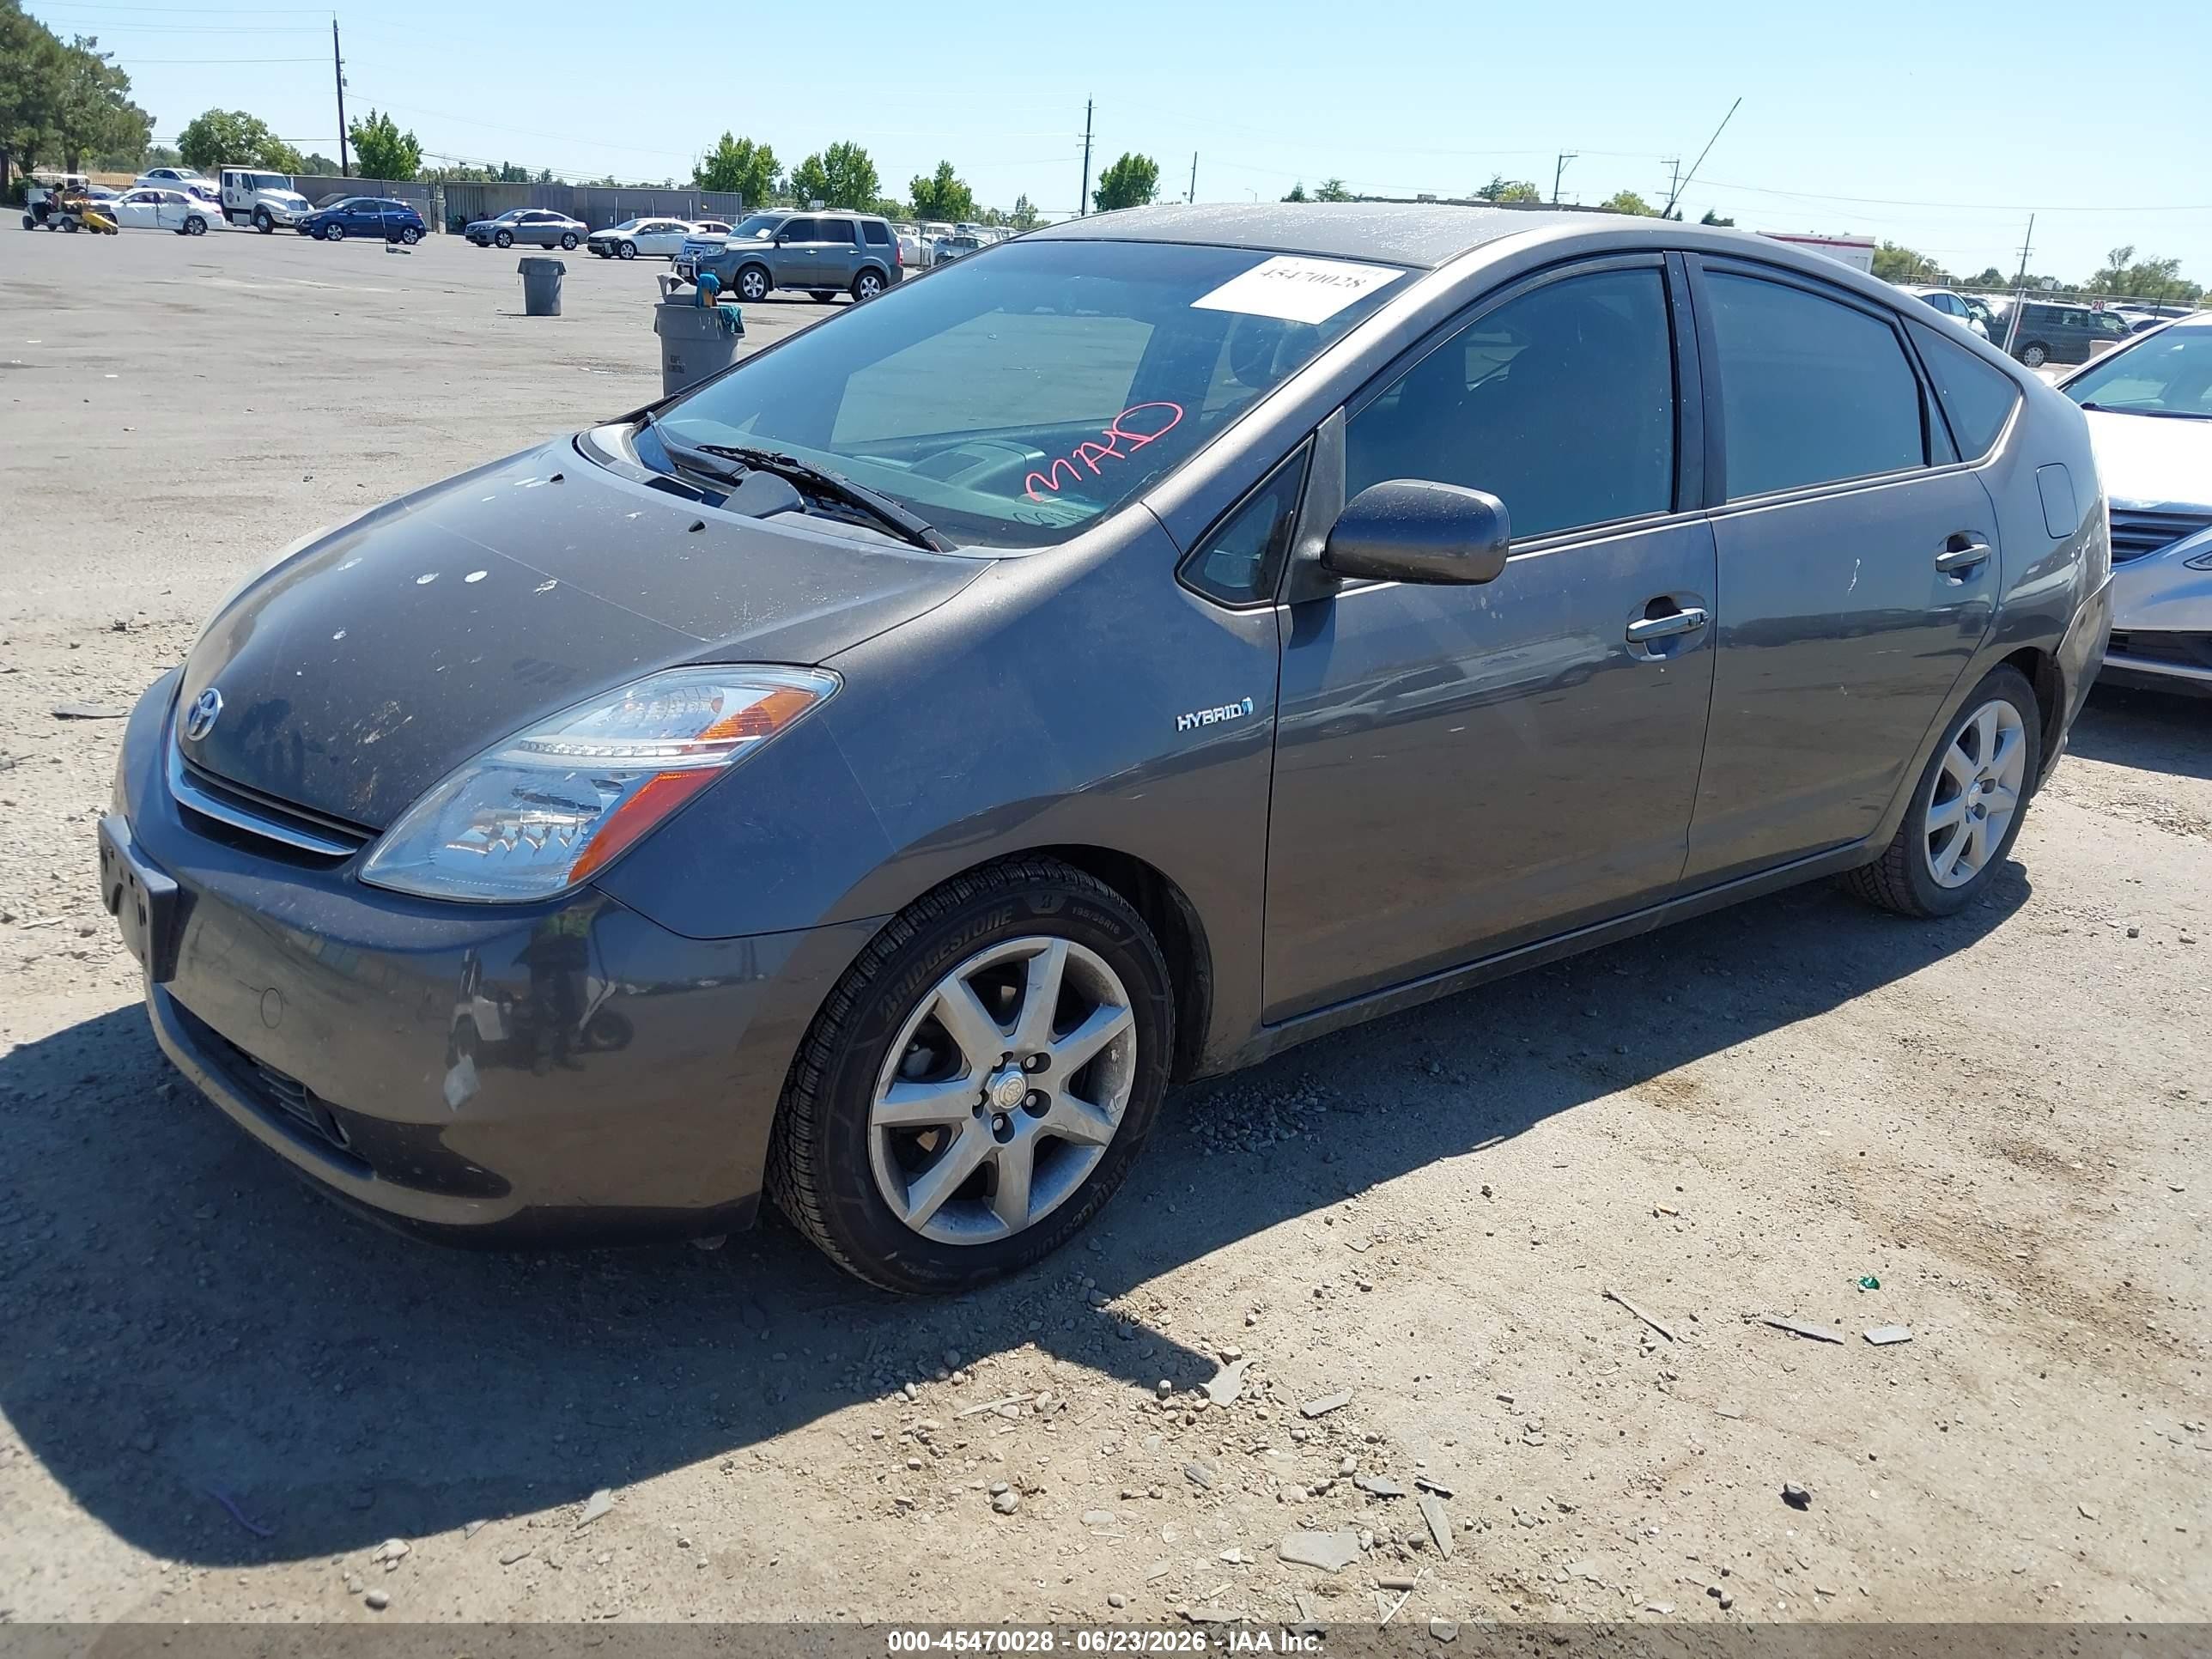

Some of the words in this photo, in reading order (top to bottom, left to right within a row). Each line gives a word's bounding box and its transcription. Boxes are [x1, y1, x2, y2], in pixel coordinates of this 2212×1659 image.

[2093, 301, 2105, 311] 20
[1176, 702, 1243, 732] HYBRID
[881, 906, 1014, 1024] BRIDGESTONE
